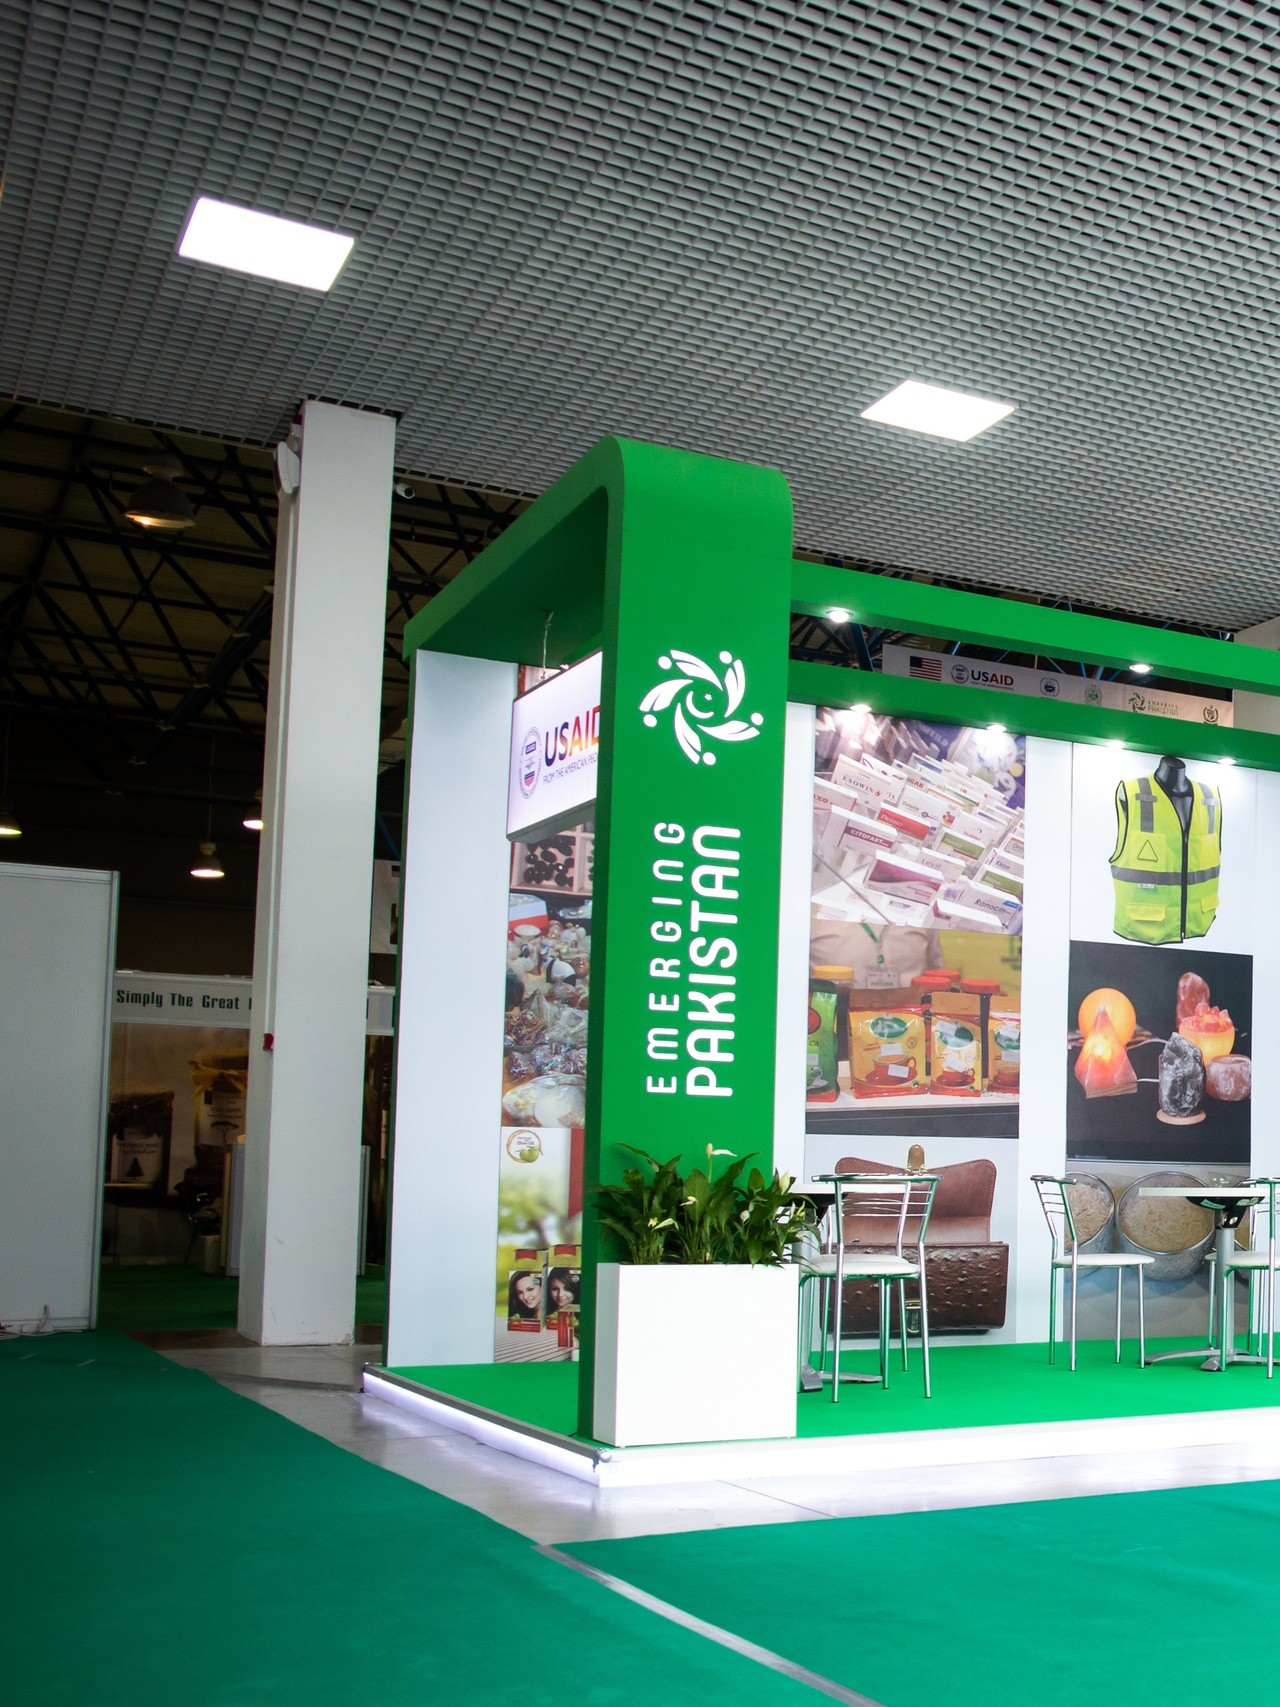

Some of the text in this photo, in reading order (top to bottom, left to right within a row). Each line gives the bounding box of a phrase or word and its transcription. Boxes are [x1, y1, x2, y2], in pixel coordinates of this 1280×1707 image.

[971, 669, 1014, 686] USAID
[545, 704, 600, 767] USAID
[842, 775, 874, 793] ESOWIN
[850, 829, 883, 844] CITOFAST
[974, 898, 1006, 914] Ranocin
[646, 822, 685, 1094] EMERGING
[686, 825, 741, 1097] PAKISTAN
[116, 989, 163, 1008] Simply
[170, 992, 193, 1007] The
[202, 994, 240, 1010] Great
